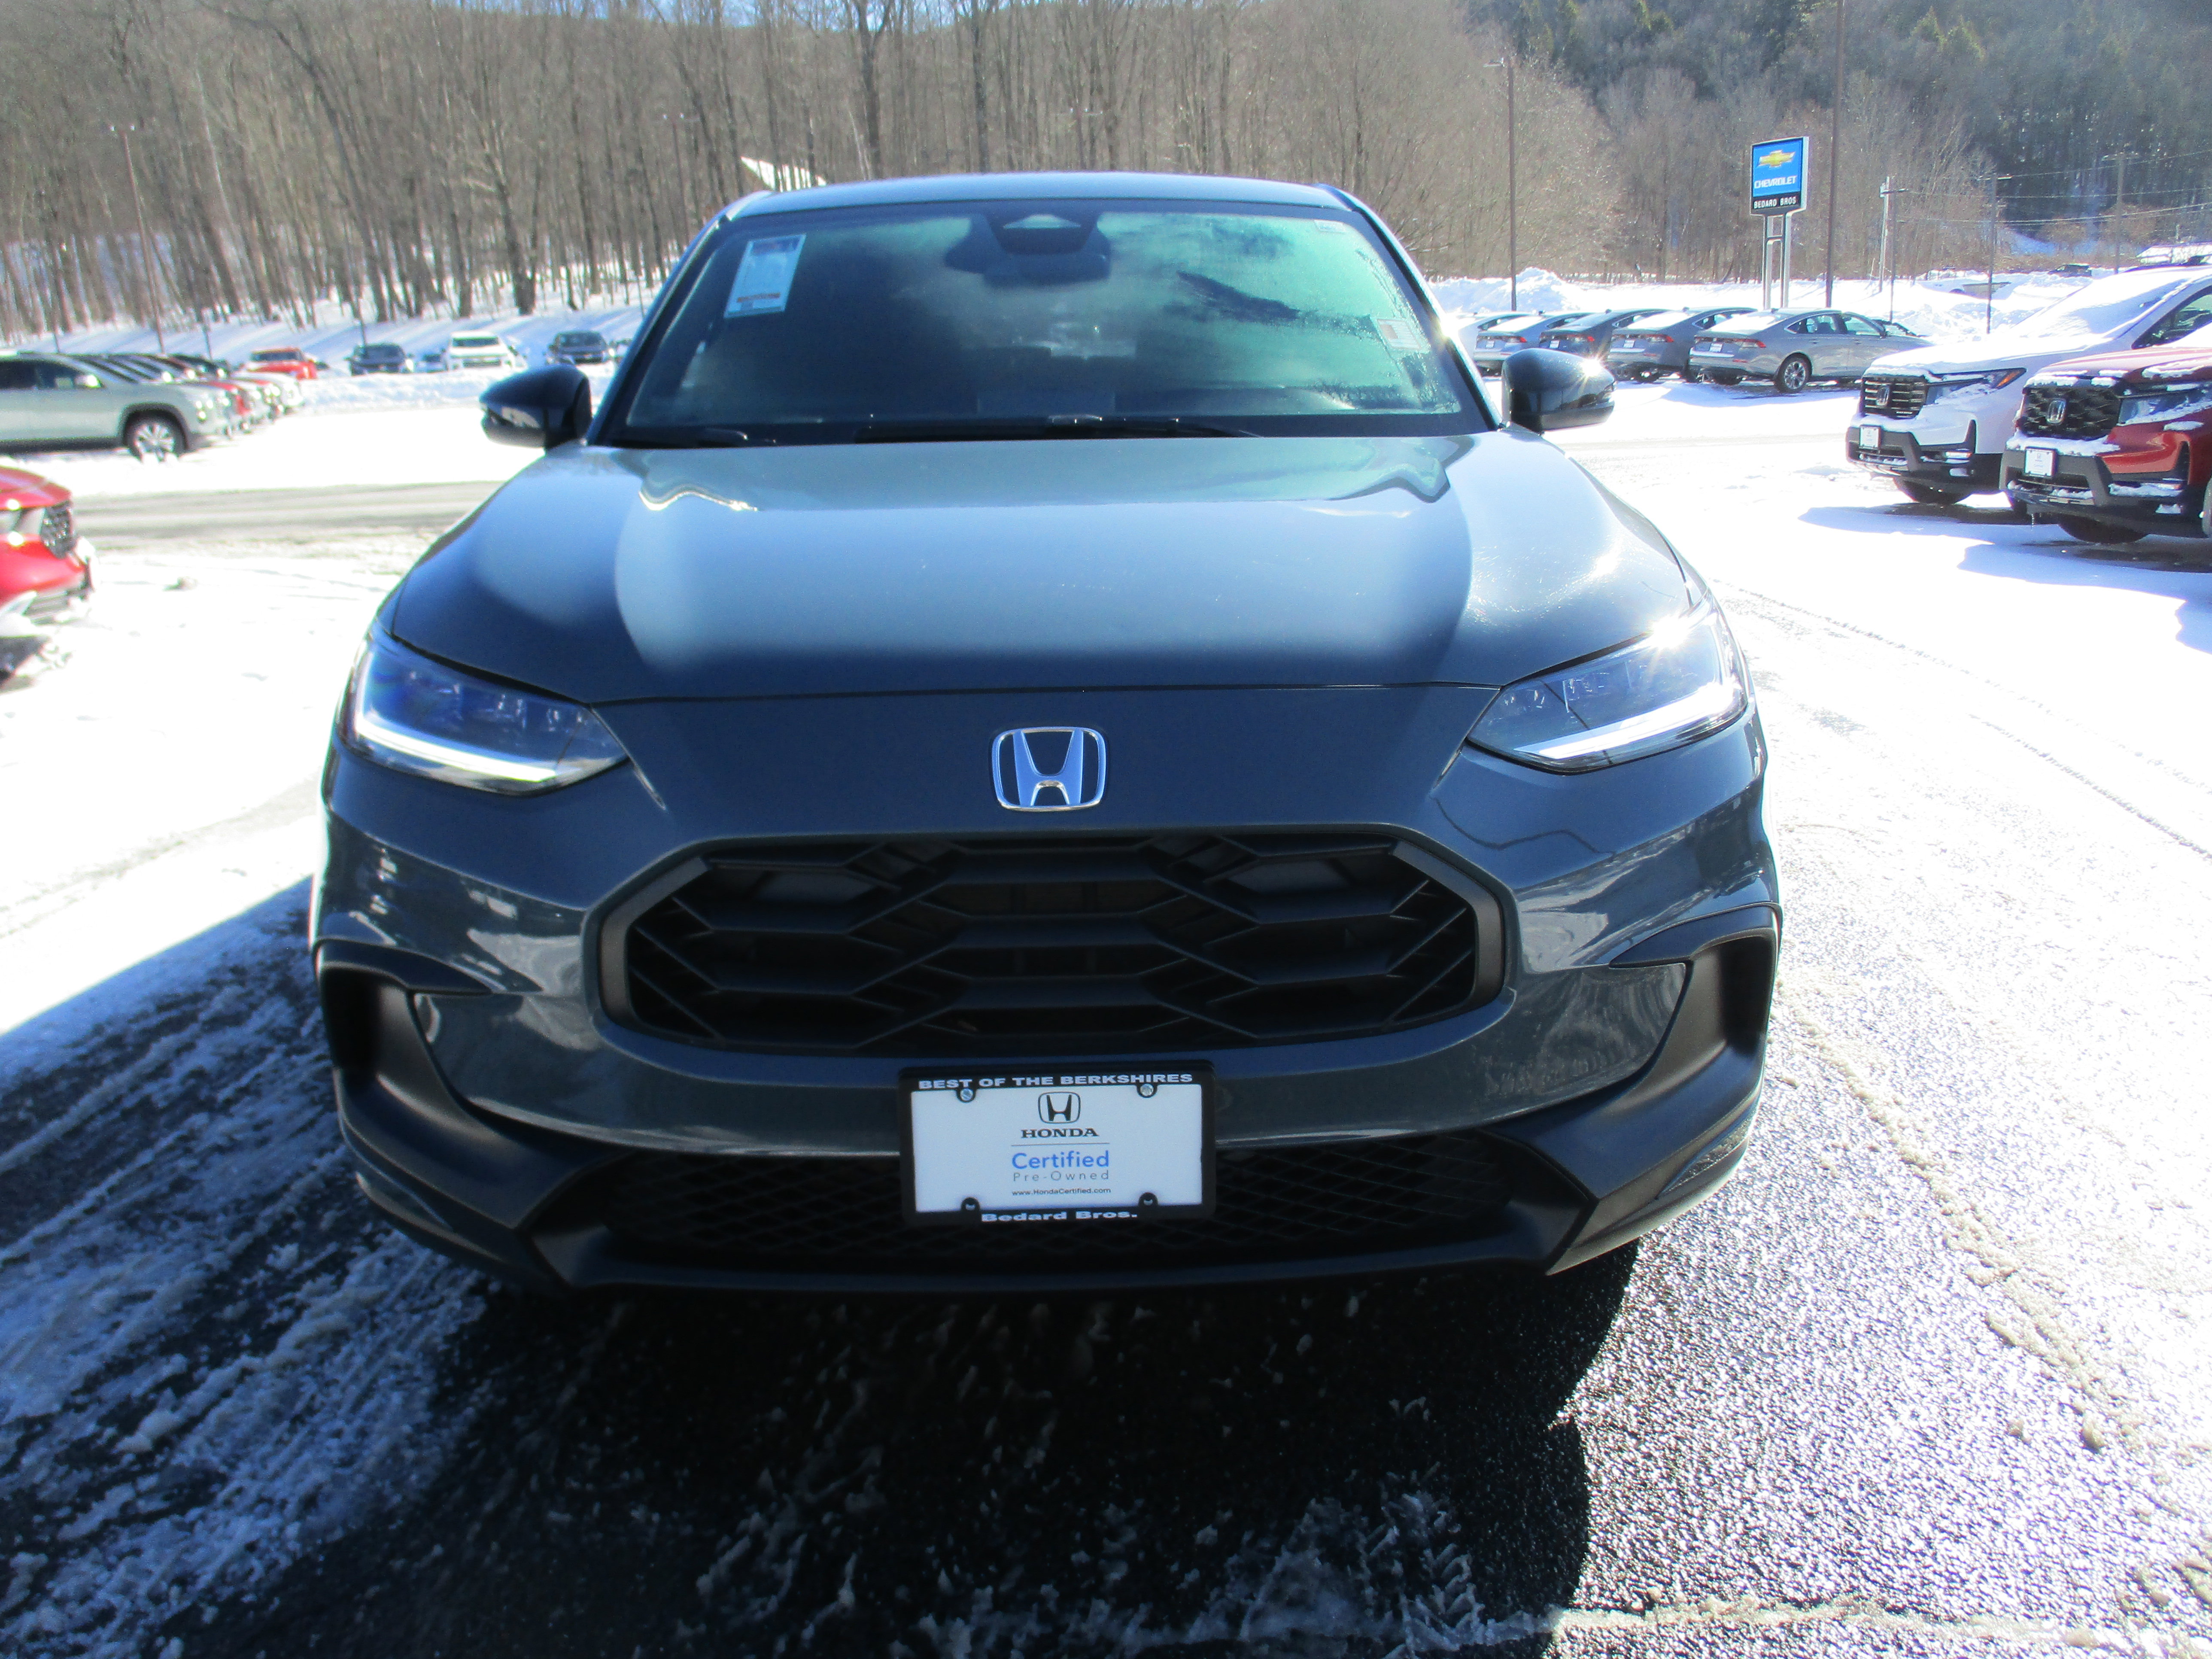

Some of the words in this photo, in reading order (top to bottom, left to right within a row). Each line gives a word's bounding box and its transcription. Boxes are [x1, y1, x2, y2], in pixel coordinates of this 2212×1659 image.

[1754, 176, 1797, 188] CHEVROLET
[1753, 198, 1777, 209] BEDARD
[1780, 196, 1796, 206] BROS
[918, 1079, 972, 1089] BEST
[978, 1078, 1006, 1087] OF
[1012, 1076, 1054, 1086] THE
[1060, 1074, 1193, 1085] BERKSHIRES
[1021, 1127, 1100, 1138] HONDA
[1012, 1150, 1109, 1169] Certified
[1013, 1170, 1109, 1181] Pre-Owned
[1012, 1188, 1111, 1196] www.HondaCertified.com
[981, 1211, 1067, 1221] Bedard
[1076, 1210, 1138, 1219] Bros.
